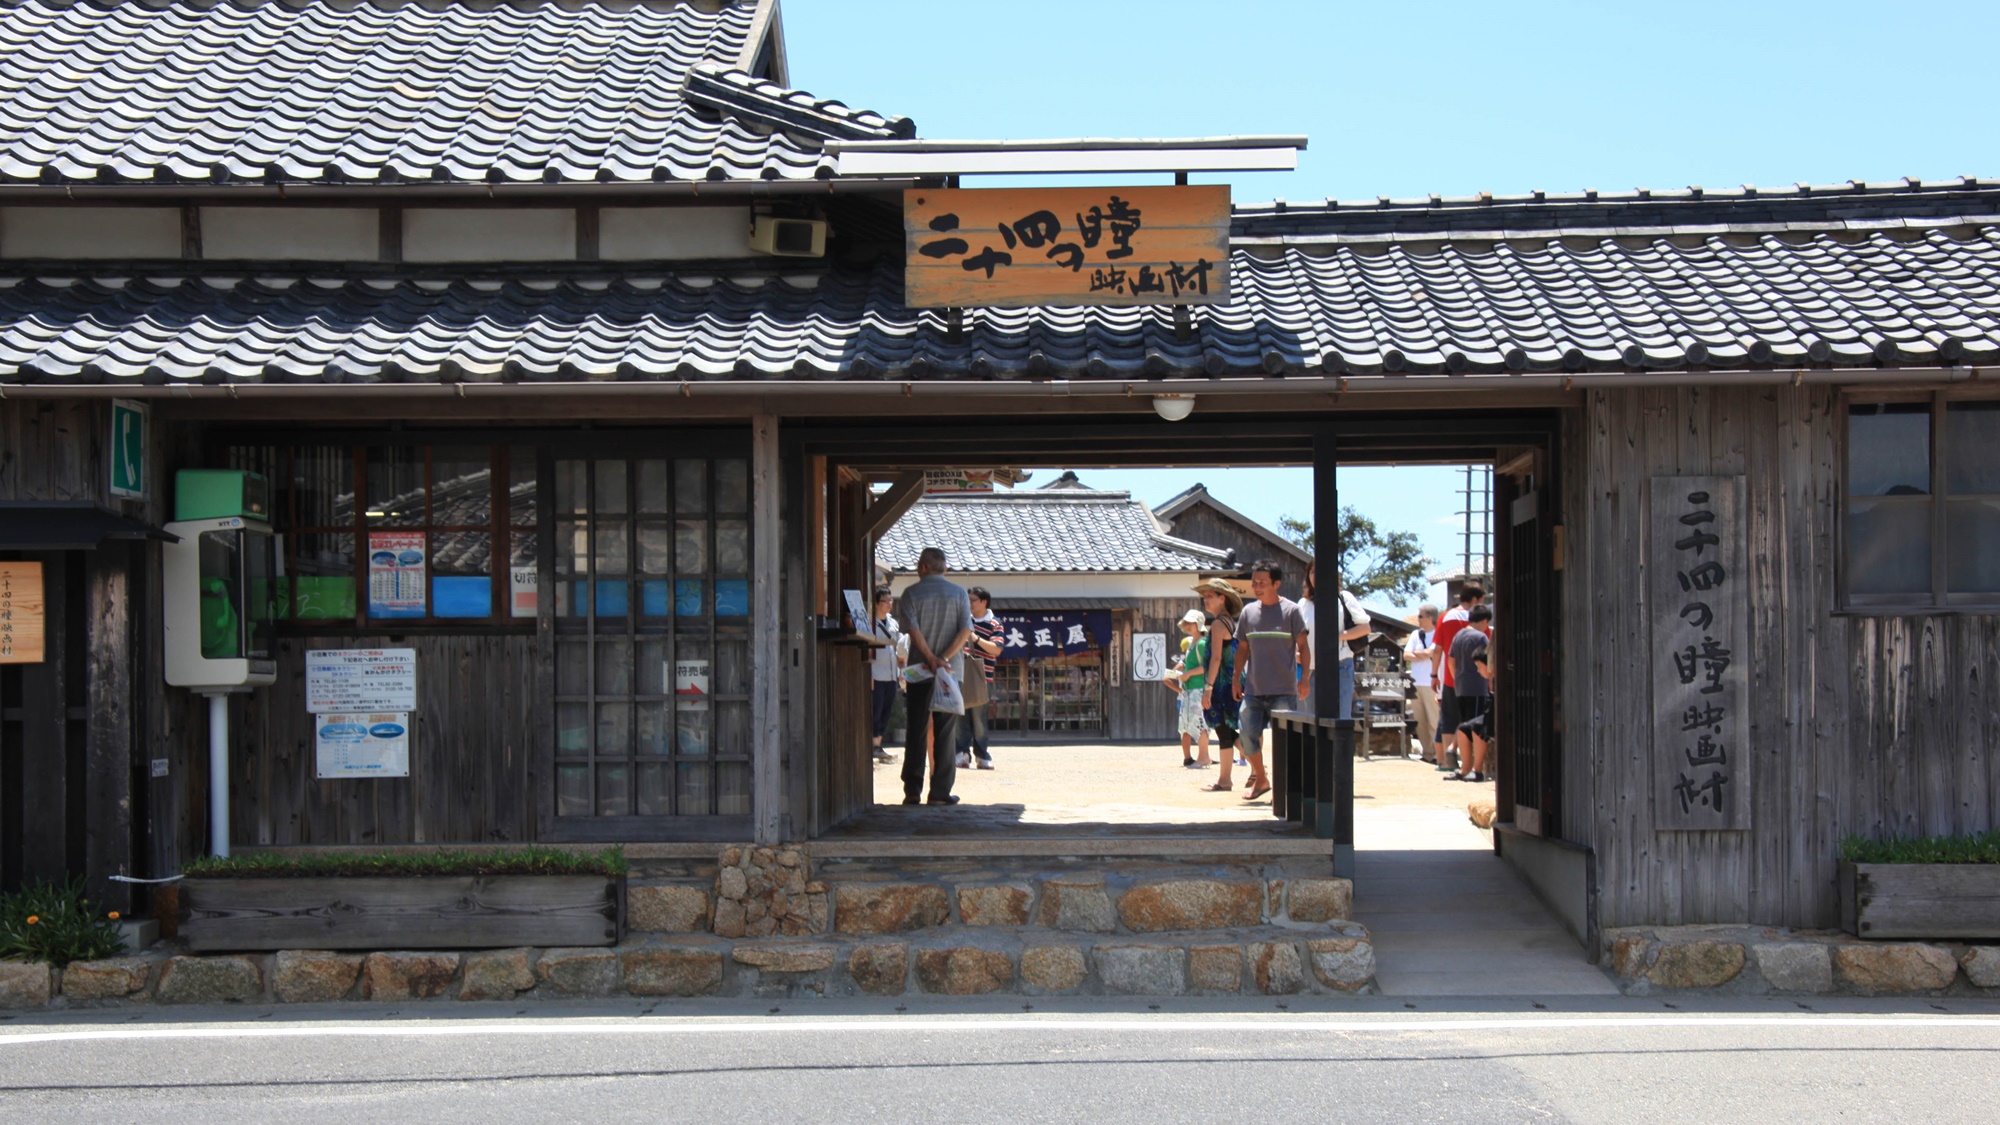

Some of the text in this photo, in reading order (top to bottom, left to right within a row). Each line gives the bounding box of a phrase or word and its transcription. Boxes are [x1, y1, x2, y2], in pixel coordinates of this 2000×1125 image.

[918, 195, 1142, 280] 二十四の瞳
[1089, 258, 1214, 298] 映画村
[1005, 624, 1087, 648] 大正屋
[1672, 490, 1732, 815] 二十四の瞳映画村
